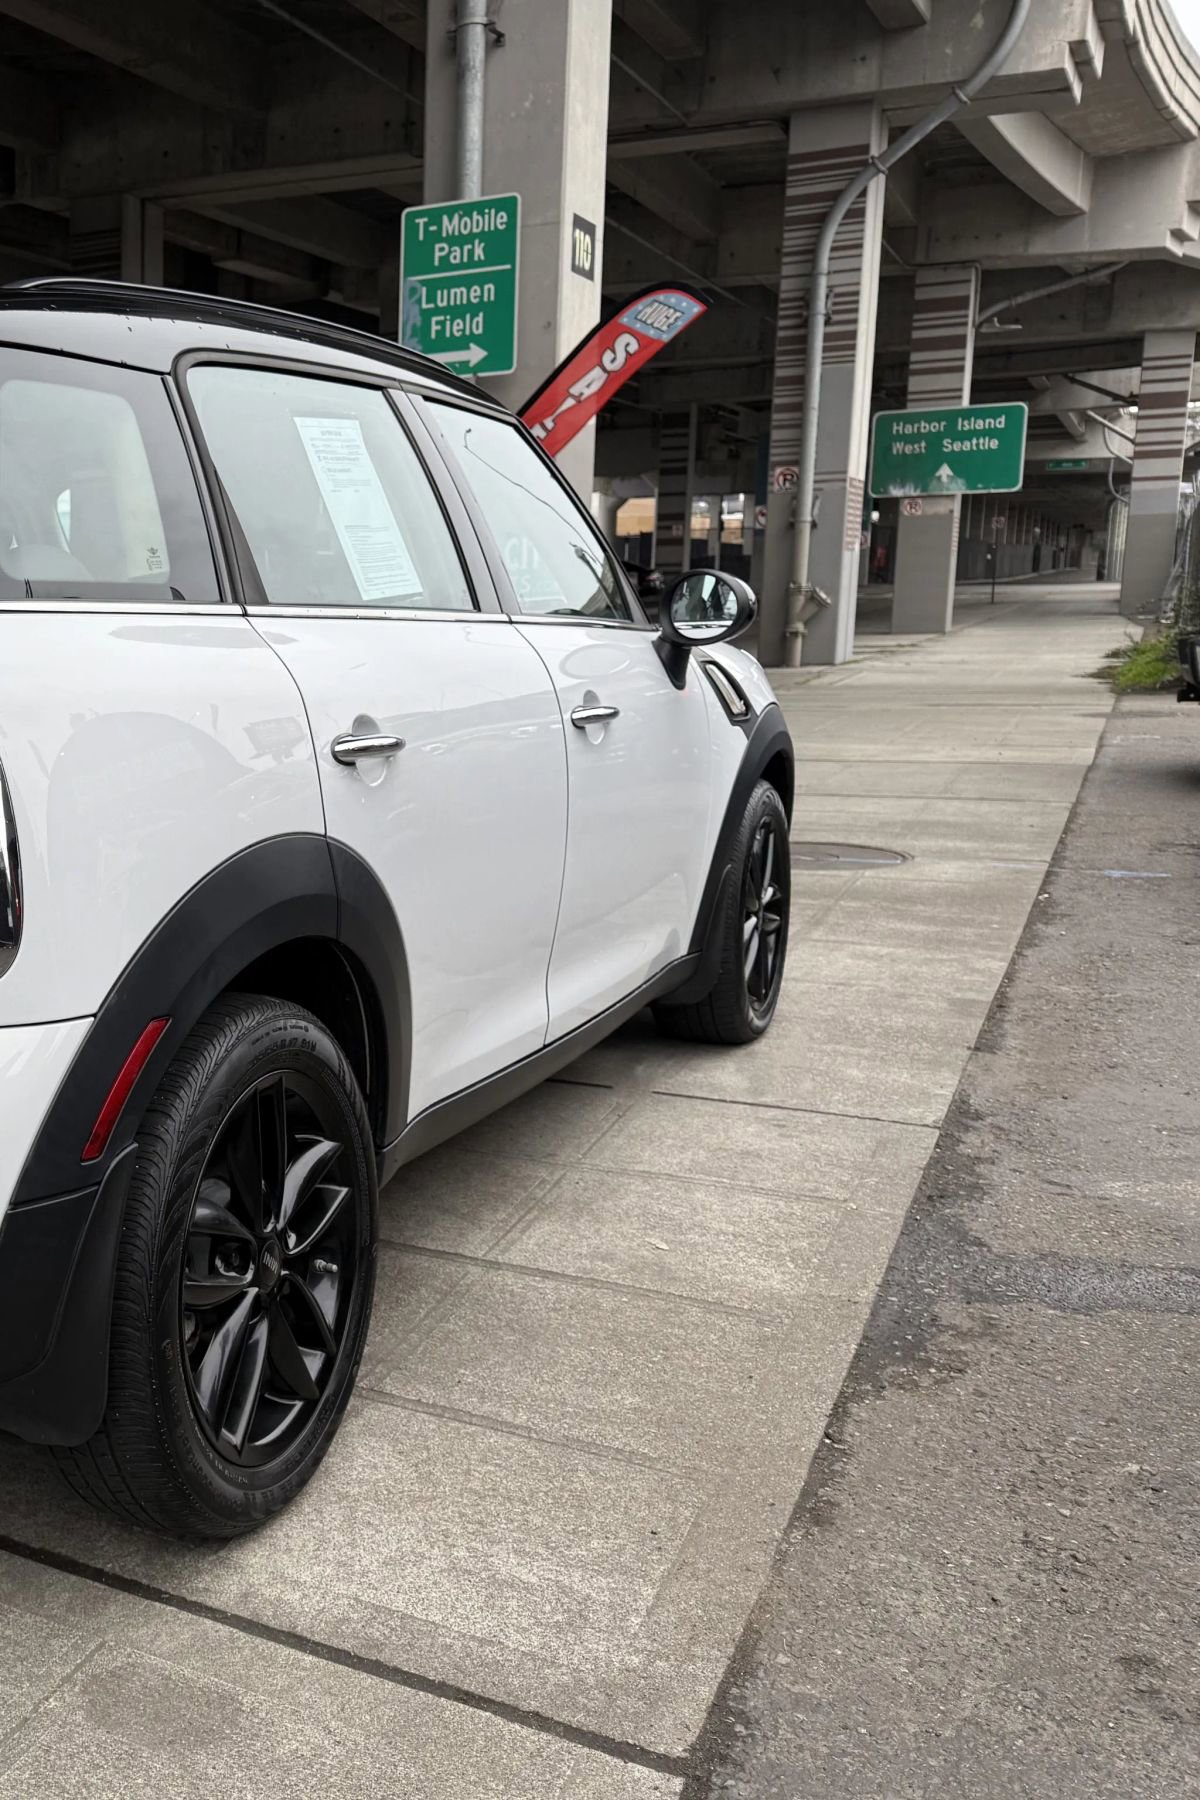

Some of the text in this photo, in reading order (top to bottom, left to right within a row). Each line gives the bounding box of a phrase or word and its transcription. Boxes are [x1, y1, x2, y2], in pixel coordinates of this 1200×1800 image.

[415, 207, 508, 241] T-Mobile
[434, 238, 485, 266] Park
[575, 228, 592, 271] 110
[421, 283, 495, 309] Lumen
[431, 312, 484, 339] Field
[635, 301, 684, 332] HUGE
[892, 415, 1006, 435] Harbor Island
[892, 437, 999, 455] West Seattle
